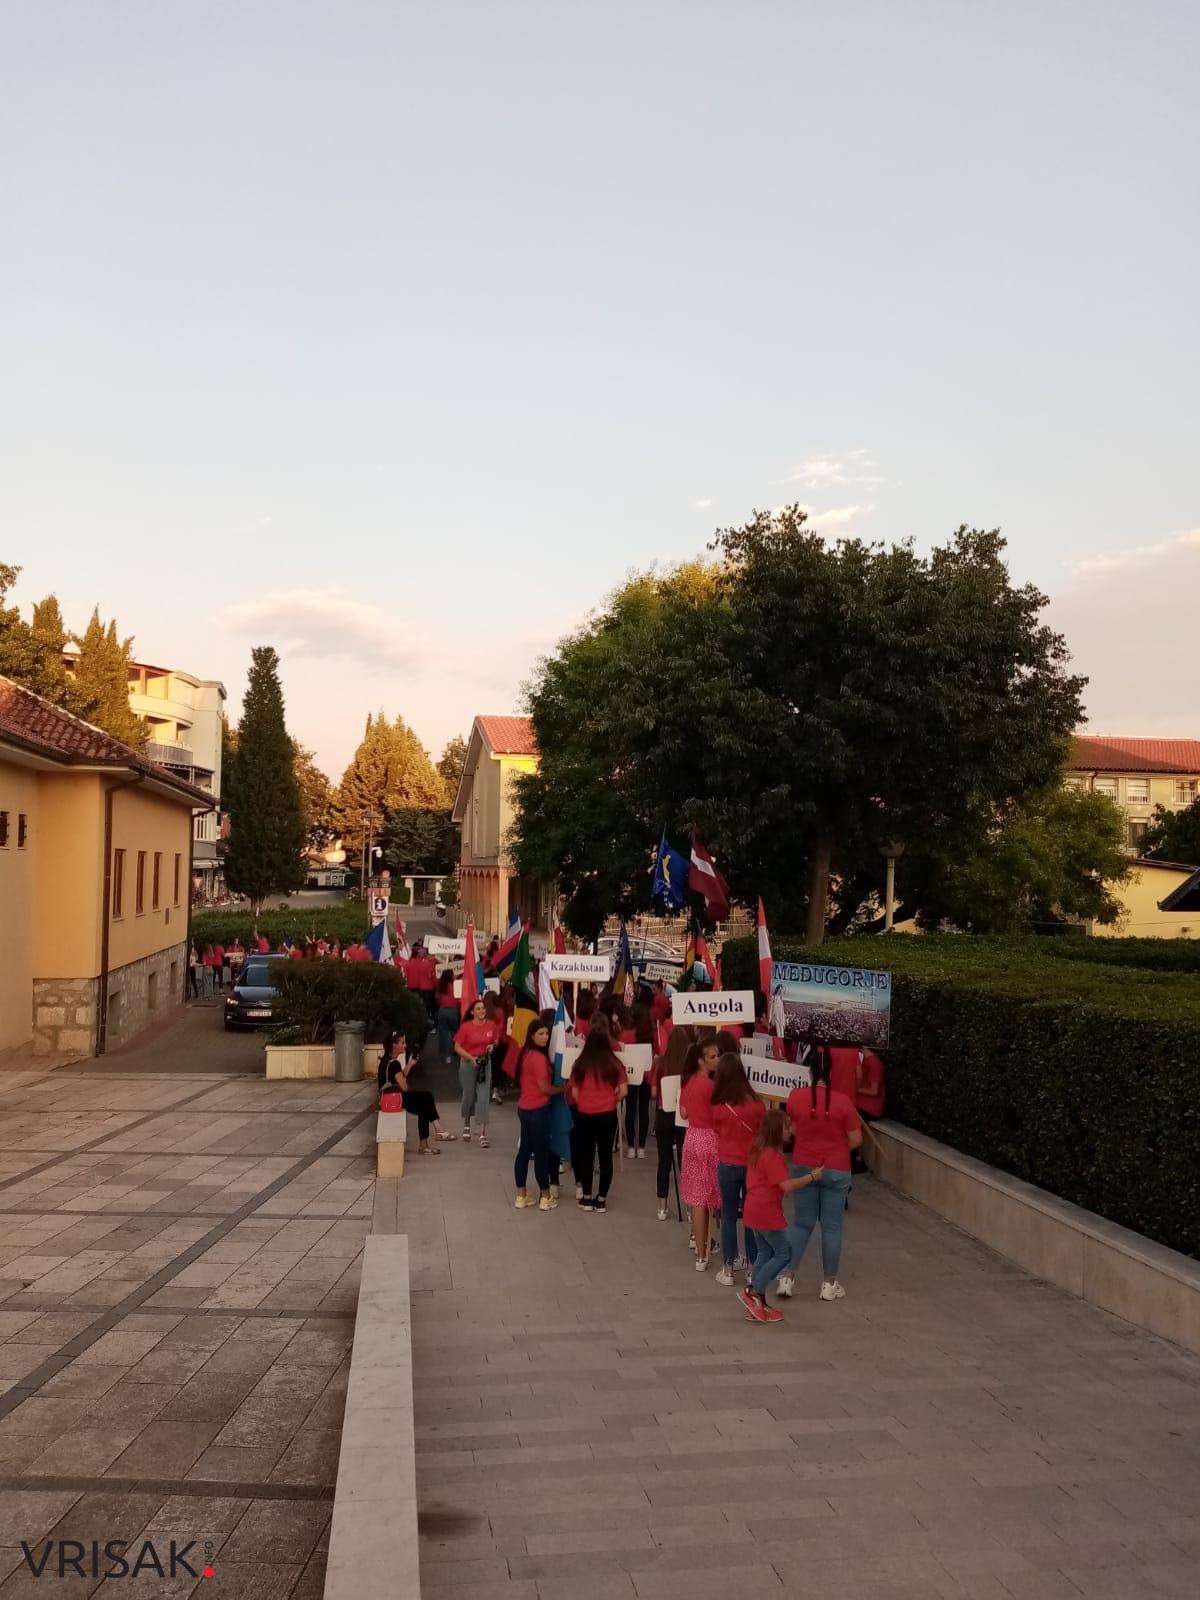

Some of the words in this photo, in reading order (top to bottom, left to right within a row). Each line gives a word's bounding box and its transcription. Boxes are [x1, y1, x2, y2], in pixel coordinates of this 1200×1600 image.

[551, 961, 604, 973] Kazakhstan
[683, 998, 743, 1017] Angola
[747, 1066, 808, 1088] Indonesia
